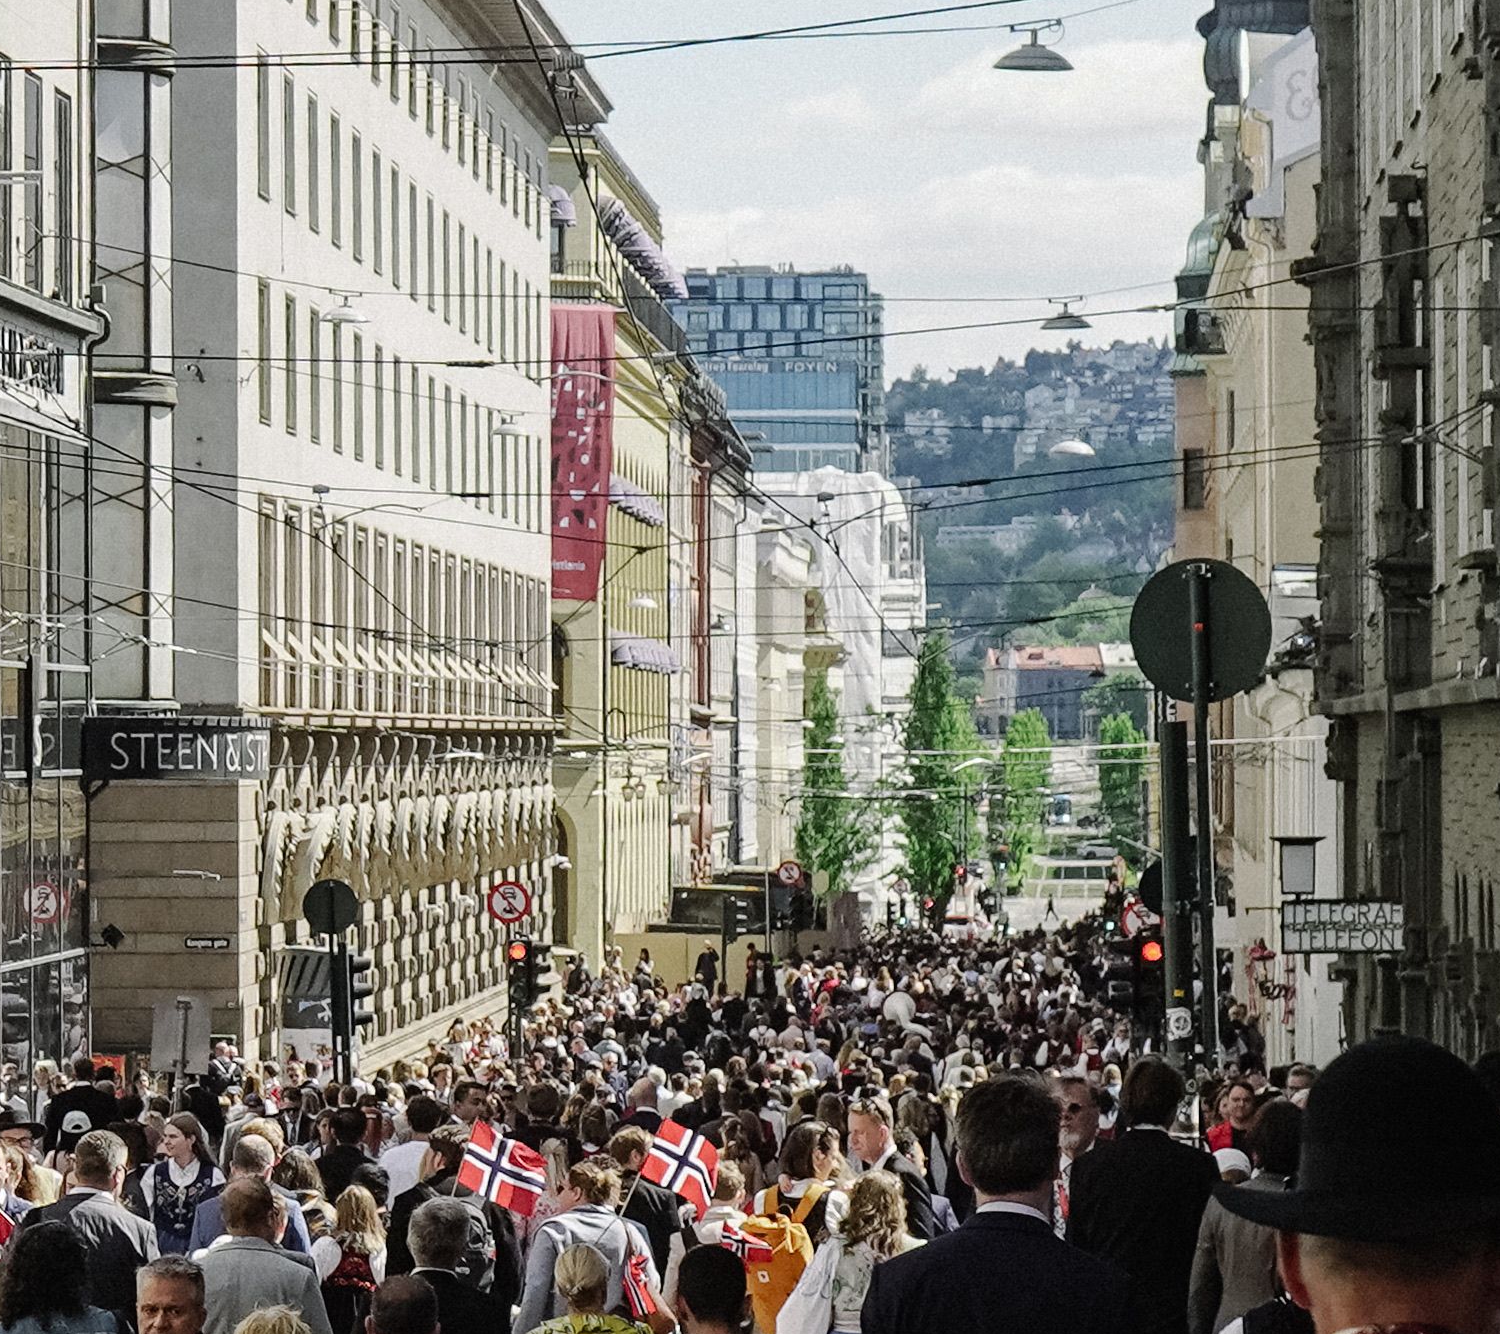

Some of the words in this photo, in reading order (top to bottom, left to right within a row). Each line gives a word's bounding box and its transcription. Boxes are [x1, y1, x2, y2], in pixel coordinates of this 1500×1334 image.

[110, 733, 218, 770] STEEN
[225, 732, 242, 772] &
[1289, 900, 1403, 925] TELEGRAF
[1291, 927, 1396, 951] TELEFON
